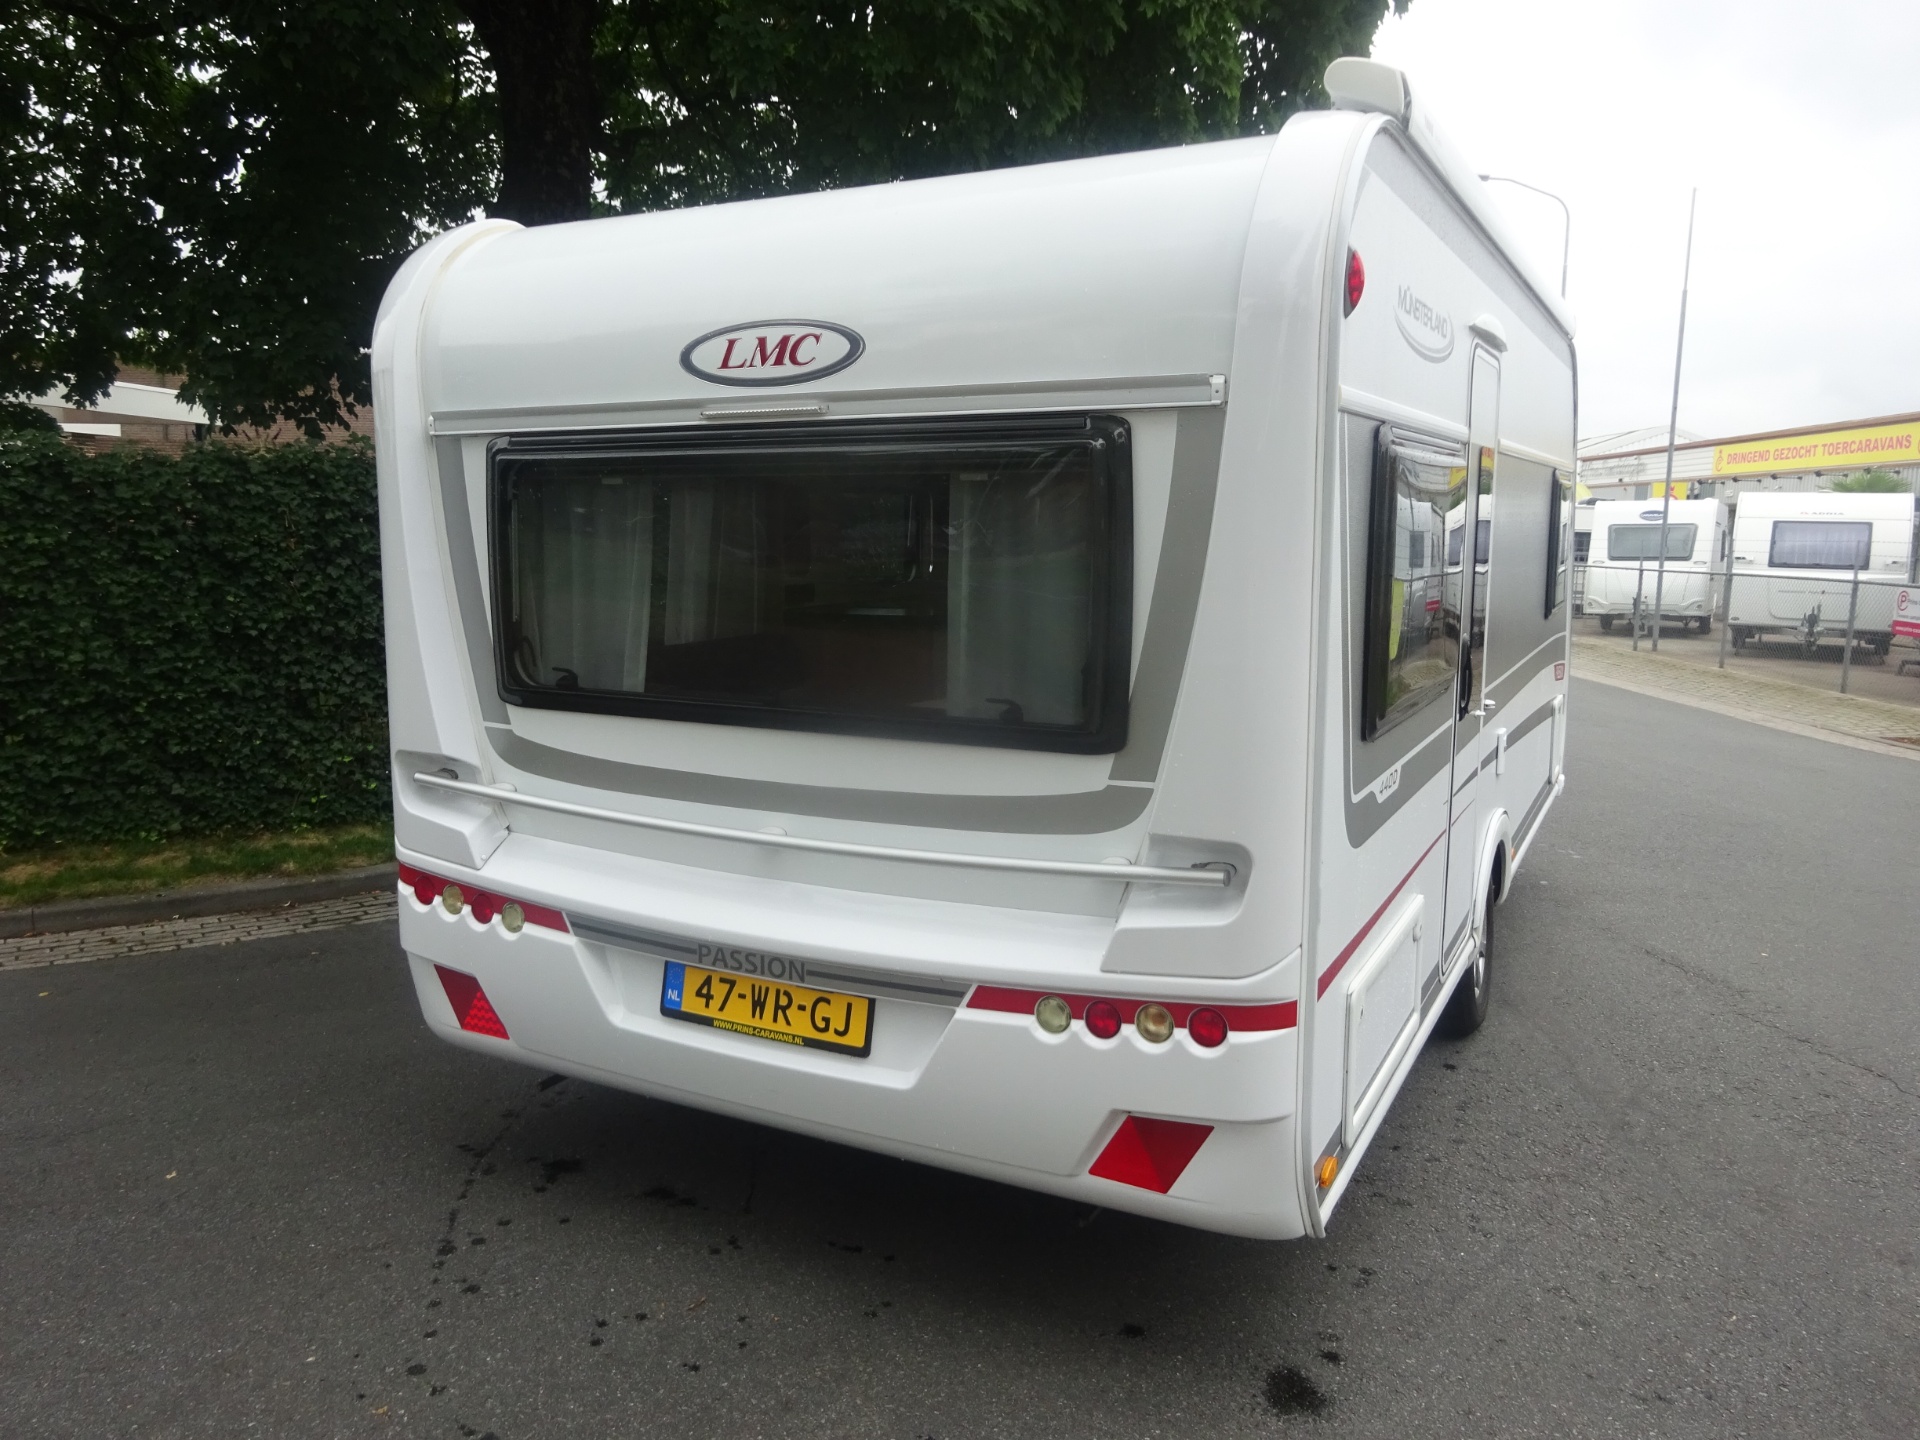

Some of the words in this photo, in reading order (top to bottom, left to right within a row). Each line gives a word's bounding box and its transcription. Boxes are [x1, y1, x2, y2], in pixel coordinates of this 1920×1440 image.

[717, 333, 822, 370] LMC
[1727, 451, 1770, 465] DRINGEND
[1773, 444, 1818, 461] GEZOCHT
[1821, 434, 1912, 457] TOERCARAVANS
[697, 943, 805, 983] PASSION
[667, 989, 680, 1002] NL
[695, 975, 853, 1038] 47-WR-GJ
[713, 1019, 805, 1046] WWW.PRINS-CARAVANS.NL
